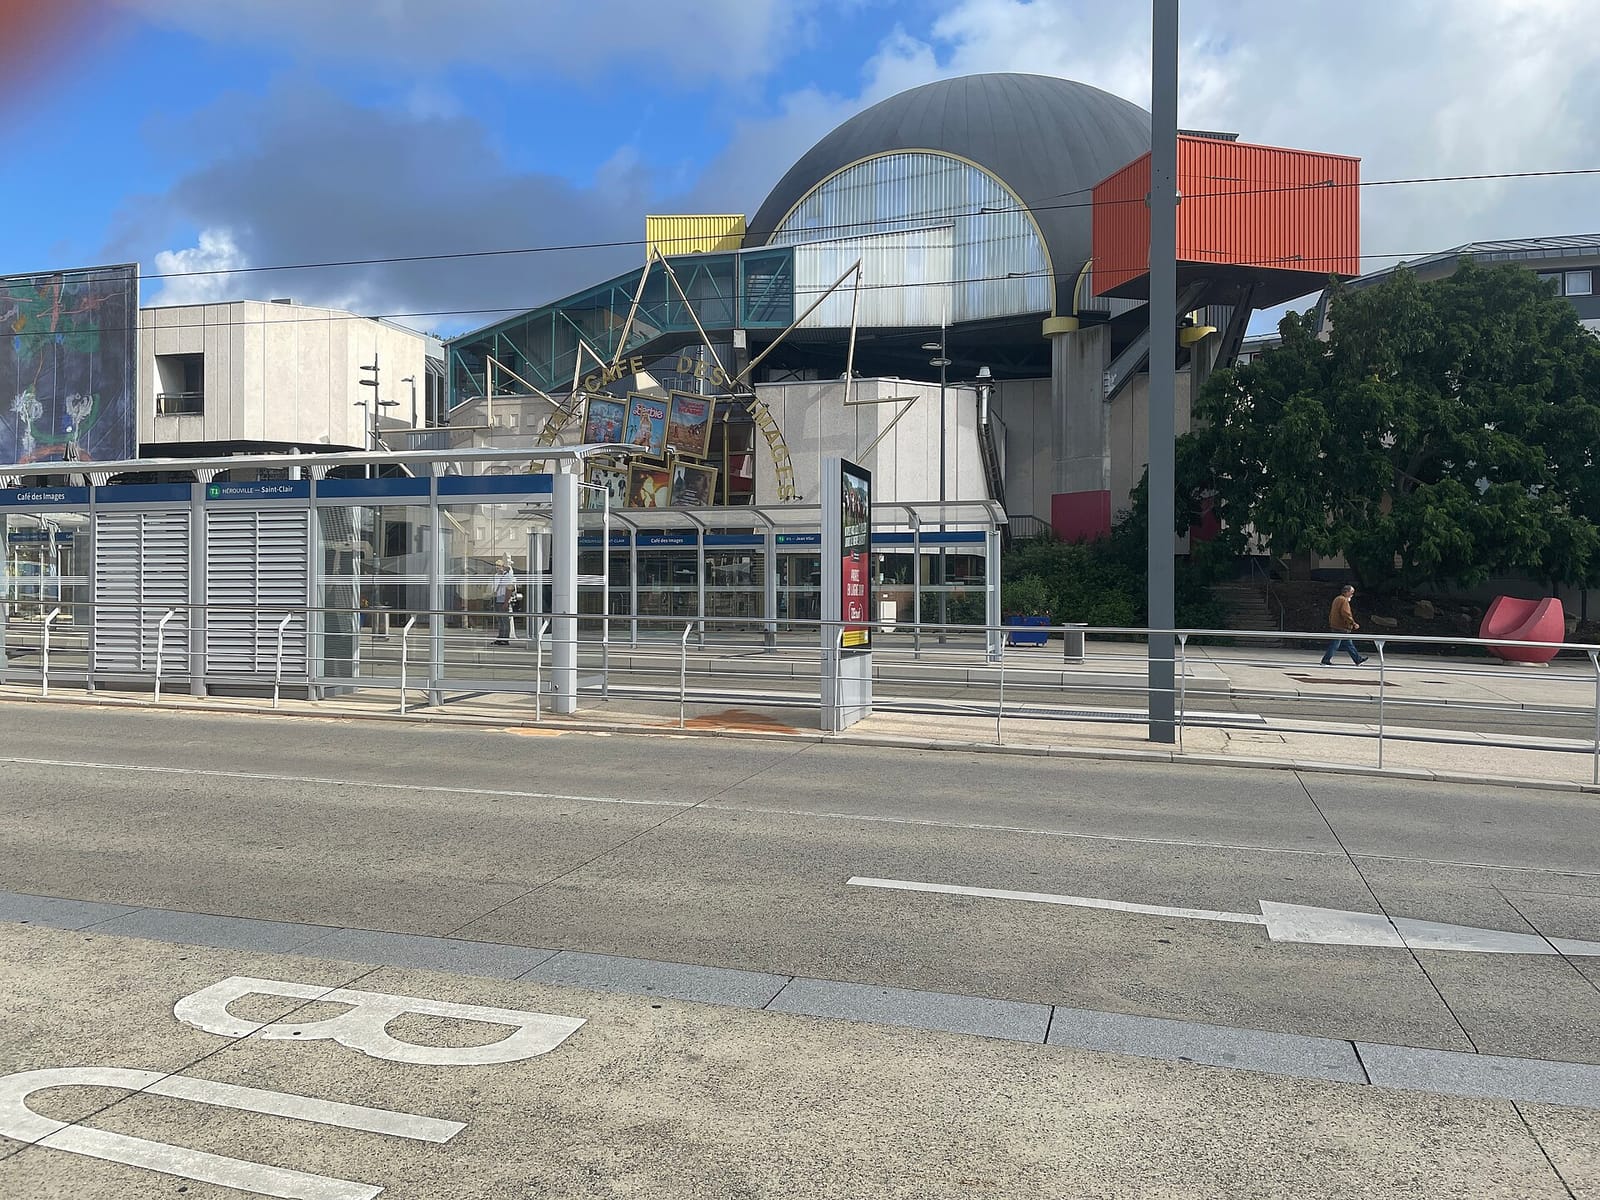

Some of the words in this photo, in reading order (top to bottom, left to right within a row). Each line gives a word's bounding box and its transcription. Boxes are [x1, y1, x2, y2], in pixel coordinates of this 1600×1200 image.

[633, 403, 664, 419] Barbie
[677, 356, 725, 386] DES
[746, 398, 795, 501] IMAGES
[17, 492, 31, 501] Café
[31, 492, 43, 500] des
[43, 492, 65, 501] Images
[210, 487, 219, 495] T1
[261, 485, 293, 493] Saint-Clair
